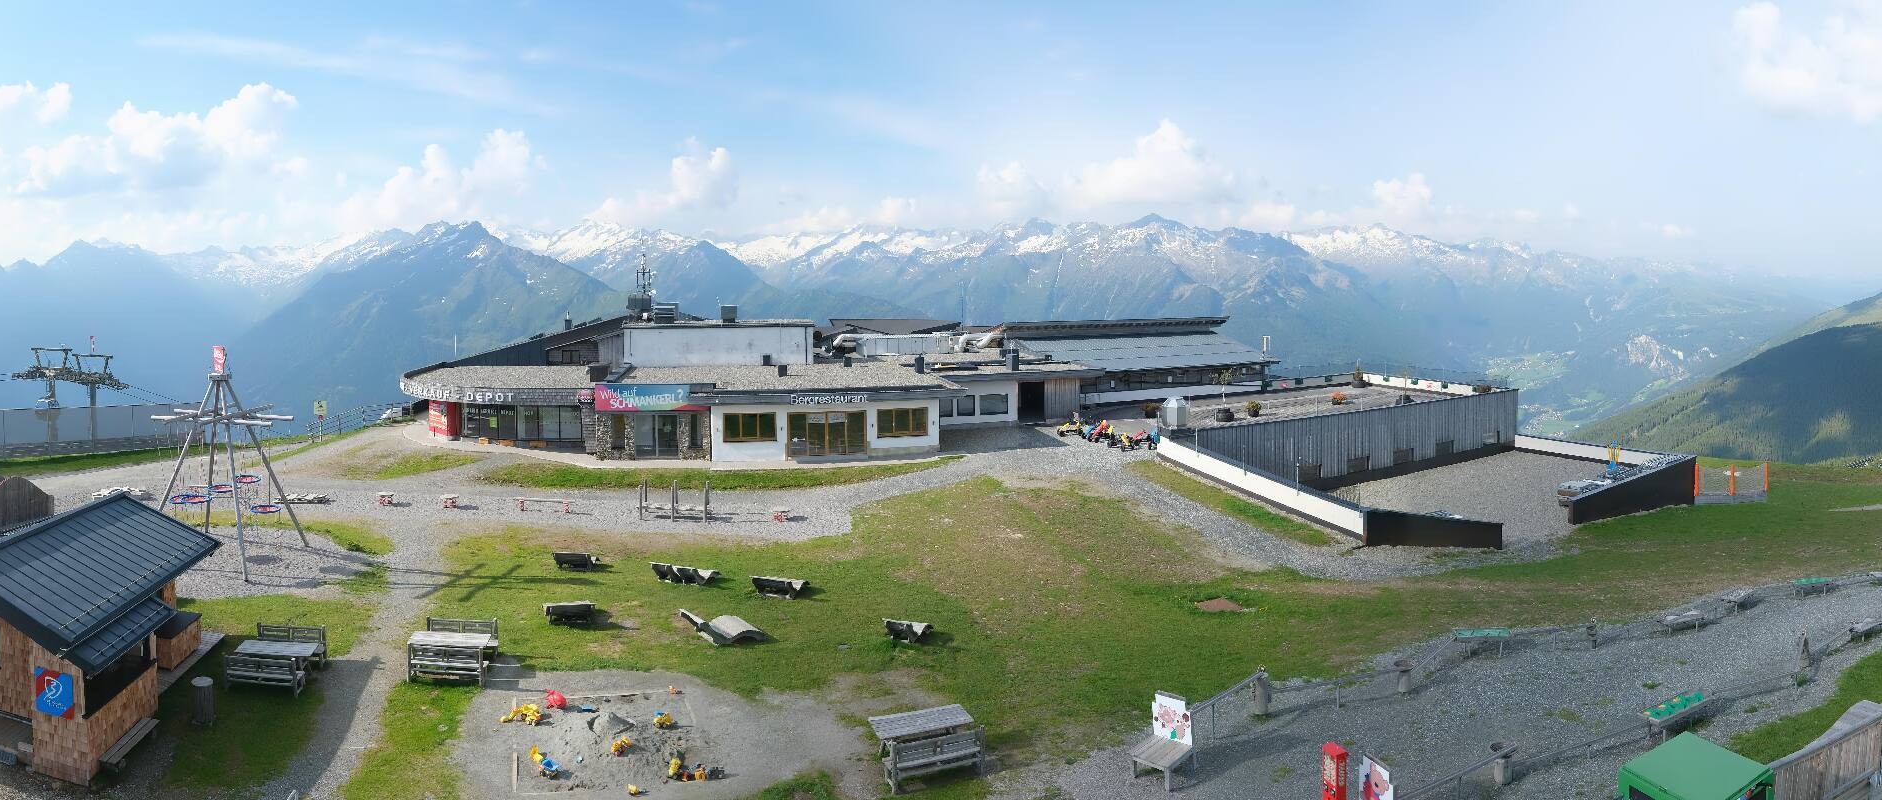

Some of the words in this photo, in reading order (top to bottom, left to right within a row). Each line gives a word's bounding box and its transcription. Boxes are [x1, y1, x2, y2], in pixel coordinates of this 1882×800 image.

[466, 392, 515, 402] DEPOT
[622, 387, 637, 398] auf
[790, 394, 868, 405] Bergrestaurant
